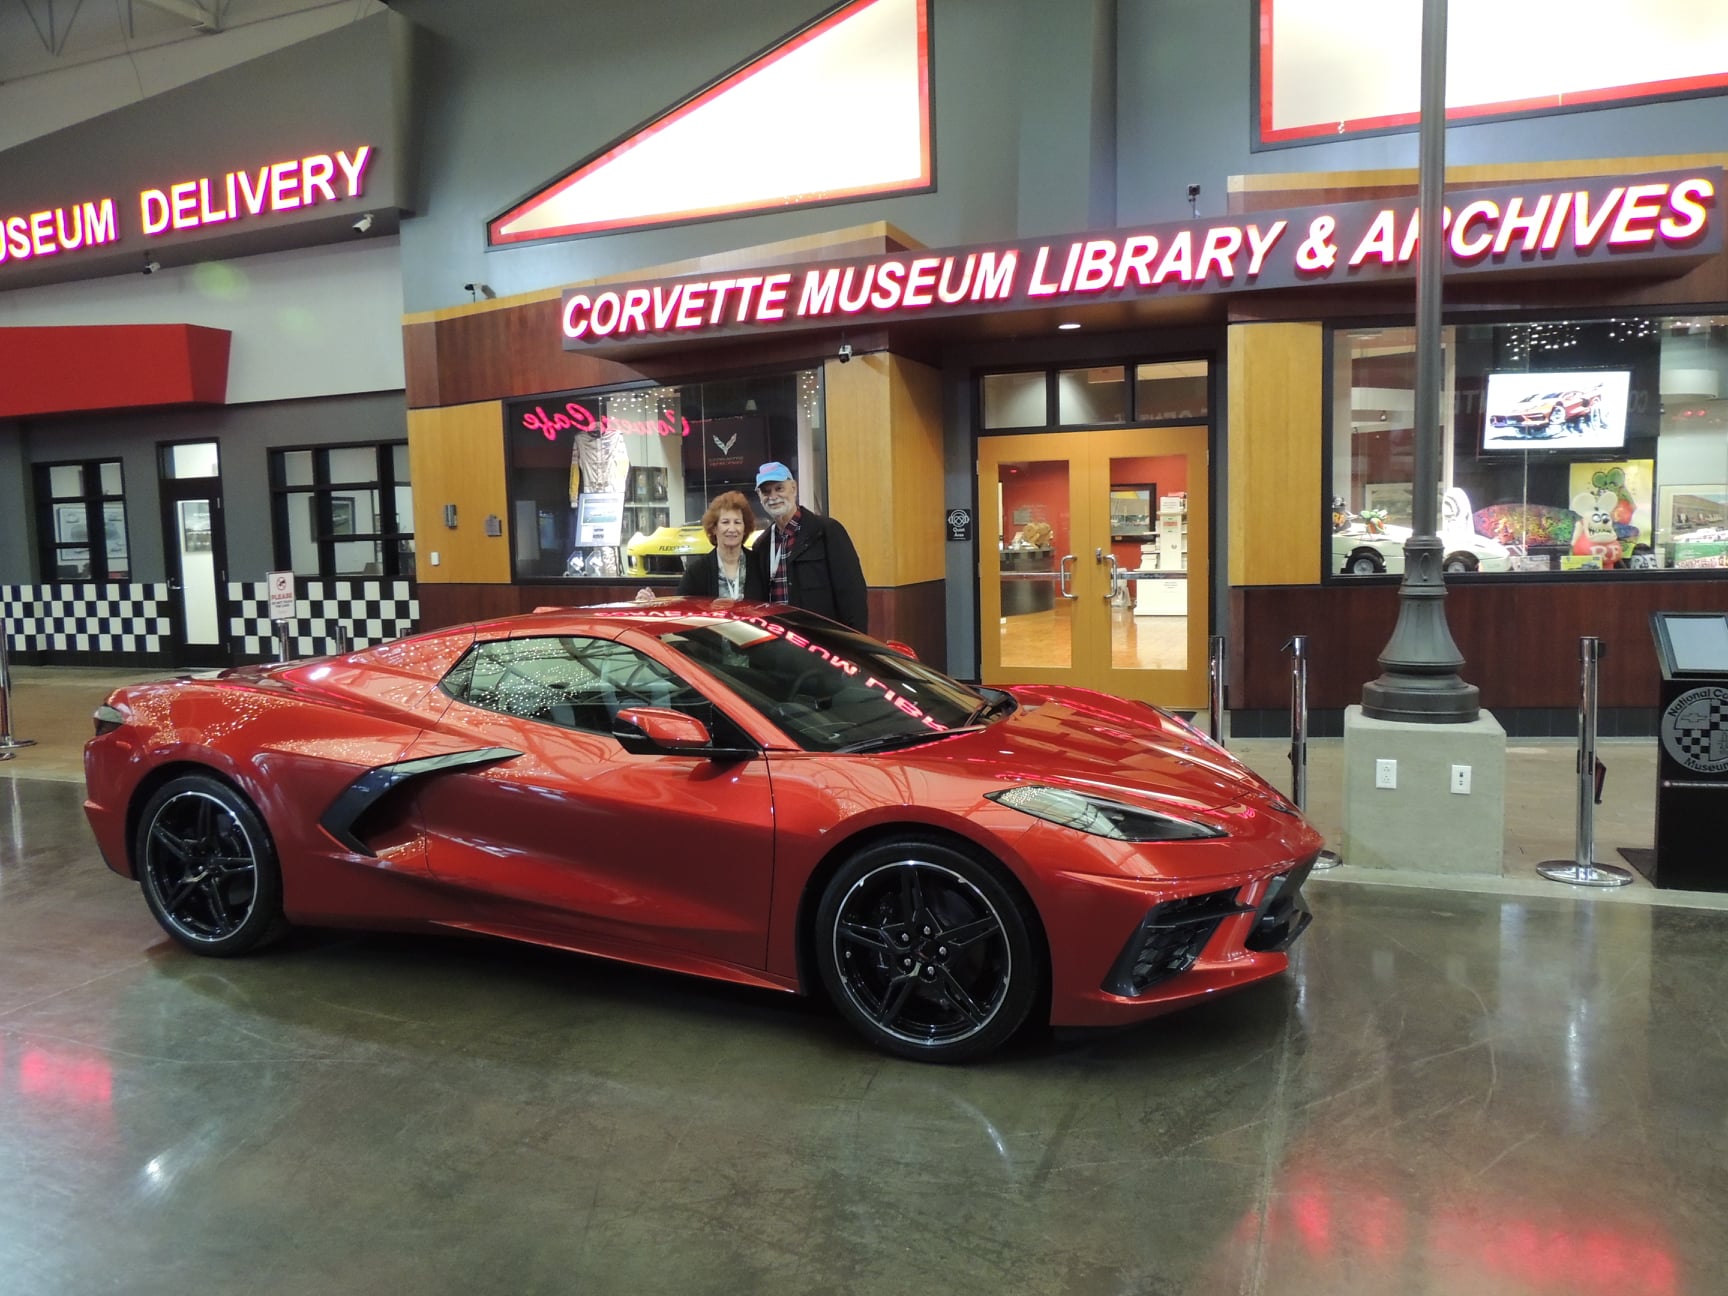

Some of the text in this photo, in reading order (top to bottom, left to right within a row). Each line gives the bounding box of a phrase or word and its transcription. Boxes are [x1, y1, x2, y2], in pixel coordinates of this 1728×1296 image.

[0, 145, 371, 264] SEUM DELIVERY
[562, 273, 792, 339] CORVETTE
[797, 250, 1019, 317] MUSEUM
[1027, 220, 1288, 297] LIBRARY
[1295, 215, 1338, 272] &
[1667, 688, 1711, 718] National
